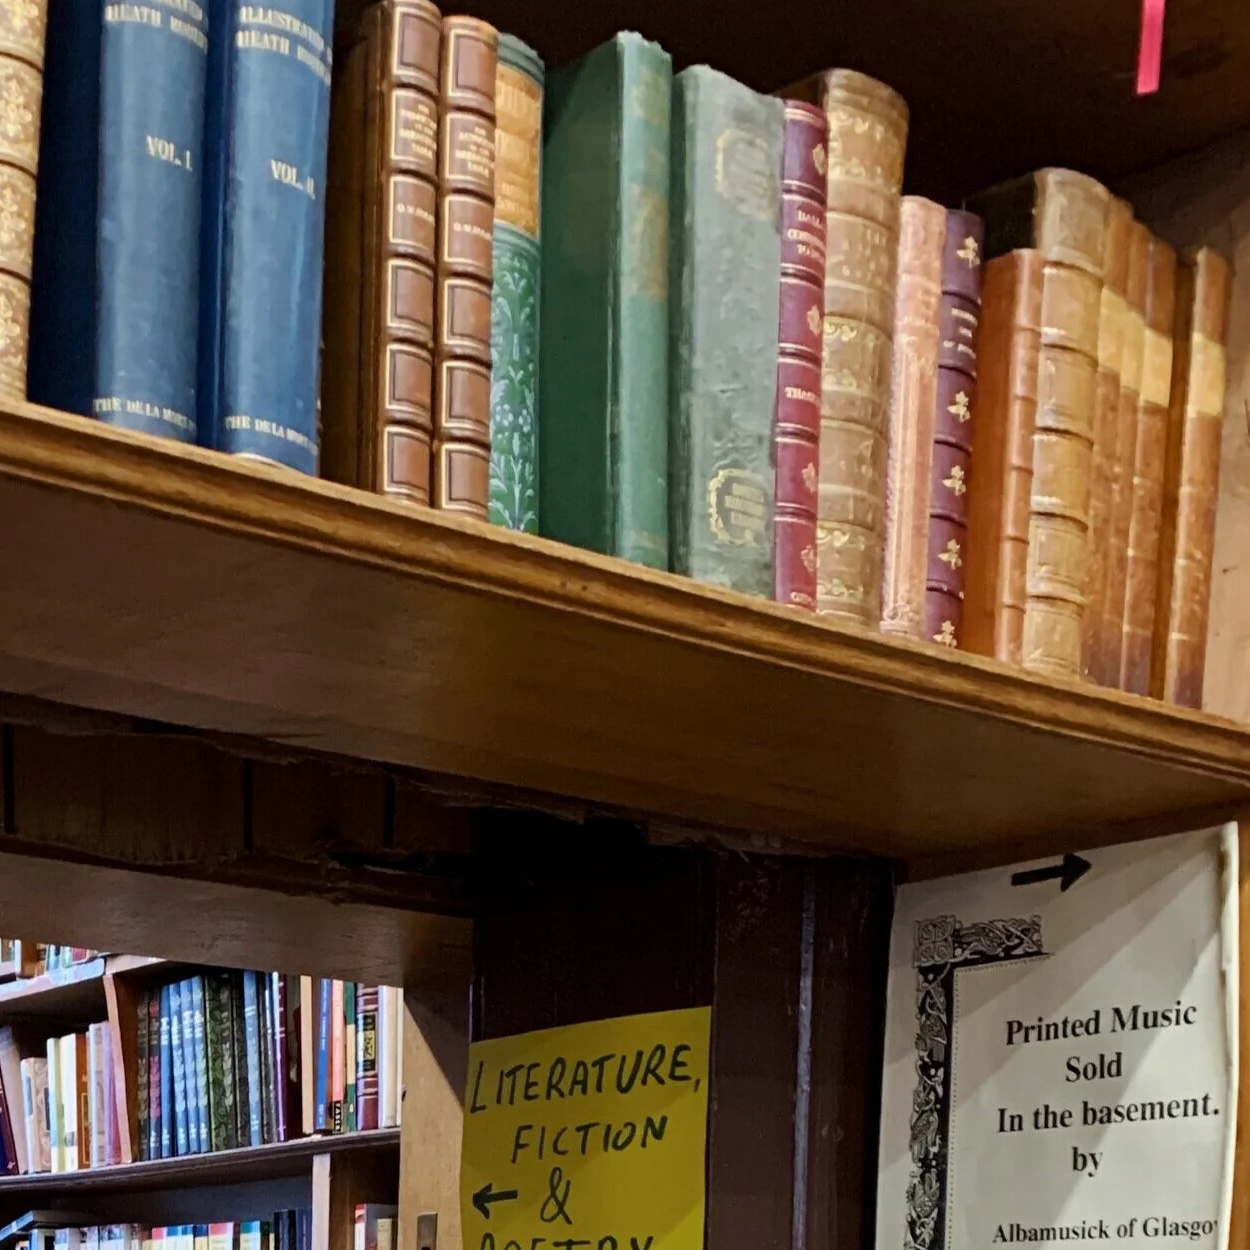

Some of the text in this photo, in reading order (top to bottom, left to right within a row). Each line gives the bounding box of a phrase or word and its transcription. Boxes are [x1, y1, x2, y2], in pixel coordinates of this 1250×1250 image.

[236, 30, 289, 56] HEATH
[146, 135, 182, 166] VOL.
[271, 159, 303, 190] VOL.
[1005, 1000, 1198, 1046] Printed Music
[470, 1044, 702, 1113] LITERATURE,
[1065, 1052, 1124, 1084] Sold
[997, 1092, 1221, 1134] In the basement.
[512, 1115, 667, 1163] FICTION
[1071, 1145, 1104, 1177] by
[540, 1167, 572, 1224] &
[992, 1219, 1111, 1245] Albamusick
[1116, 1218, 1138, 1238] of
